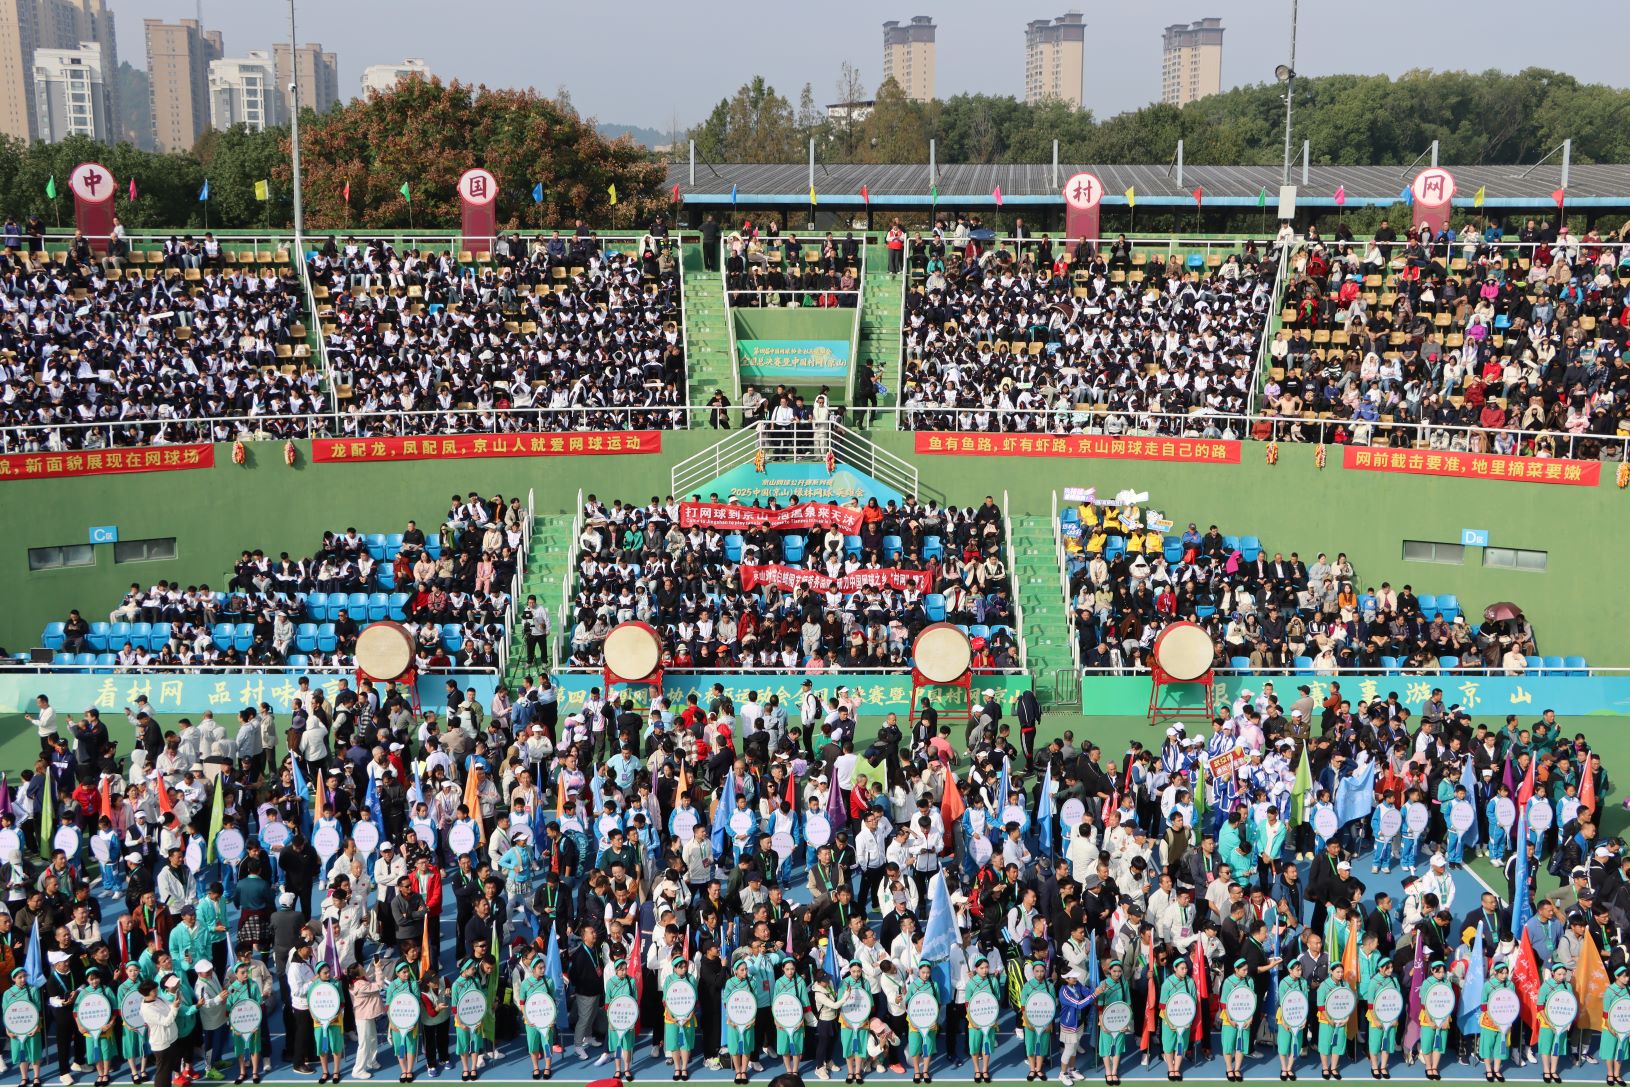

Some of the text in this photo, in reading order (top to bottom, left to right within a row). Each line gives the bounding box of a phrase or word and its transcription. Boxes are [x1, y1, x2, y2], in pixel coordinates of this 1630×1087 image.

[84, 168, 102, 197] 中
[468, 175, 487, 200] 国
[1072, 179, 1092, 204] 村
[1422, 175, 1446, 201] 网
[331, 436, 641, 459] 龙配龙，凤配凤，京山人就爱网球运动
[929, 435, 1227, 460] 鱼有鱼路，虾有虾路，京山网球走自己的路
[1355, 450, 1582, 481] 网前截击要准，地里摘菜要嫩
[94, 528, 113, 542] C区
[1466, 531, 1484, 545] D区
